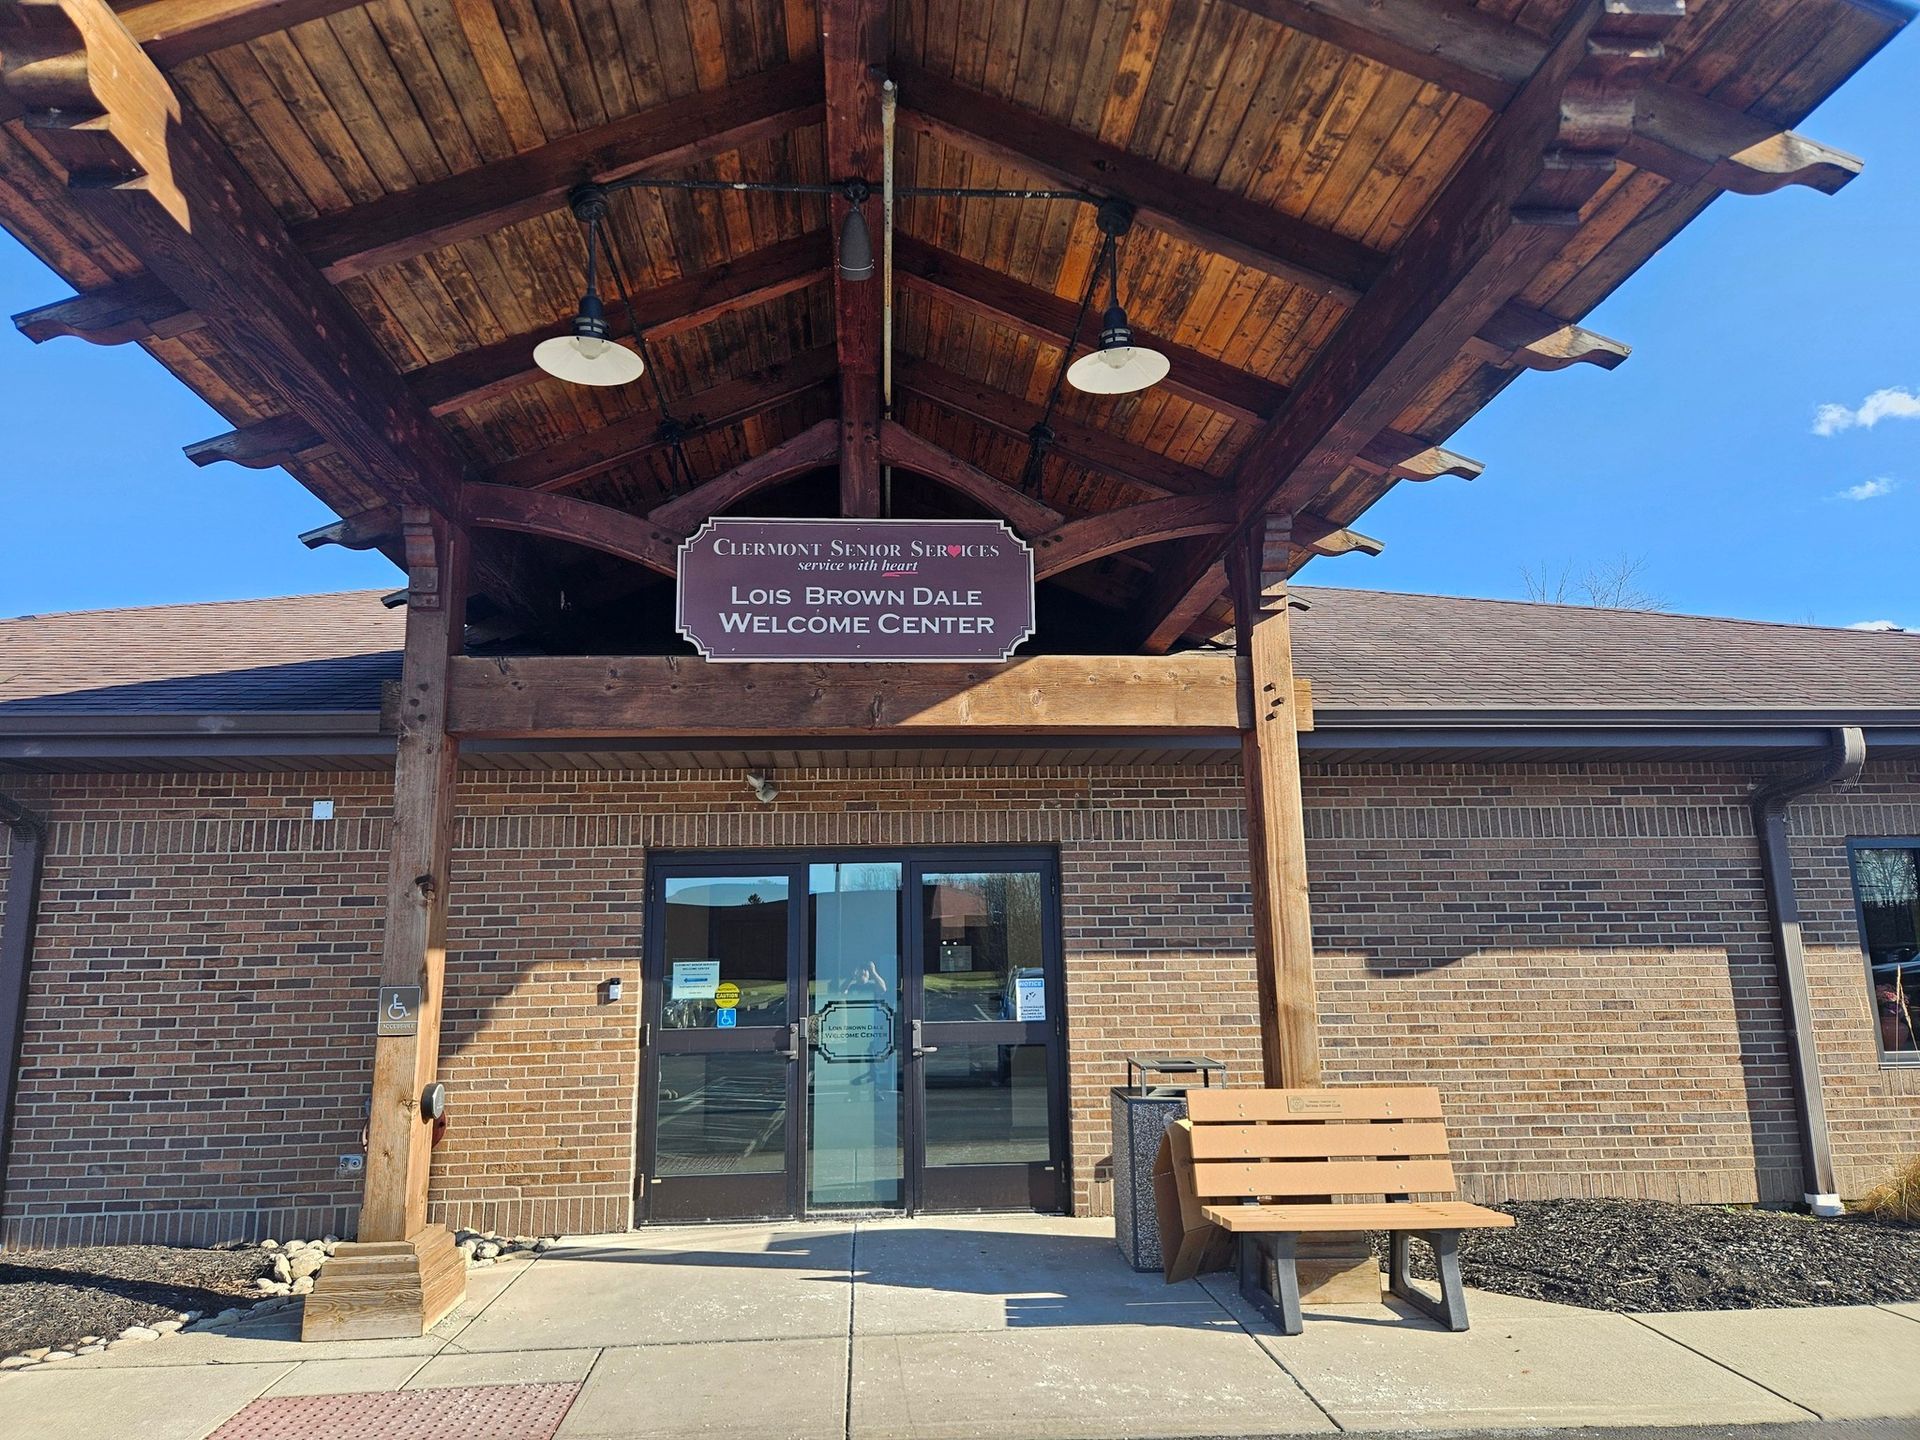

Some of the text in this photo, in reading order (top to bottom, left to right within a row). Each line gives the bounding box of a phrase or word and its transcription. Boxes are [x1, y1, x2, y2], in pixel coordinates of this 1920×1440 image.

[713, 538, 822, 556] CLERMONT
[830, 539, 902, 558] SENIOR
[797, 559, 918, 572] service with heart
[731, 586, 983, 606] LOIS BROWN DALE
[719, 612, 995, 634] WELCOME CENTER
